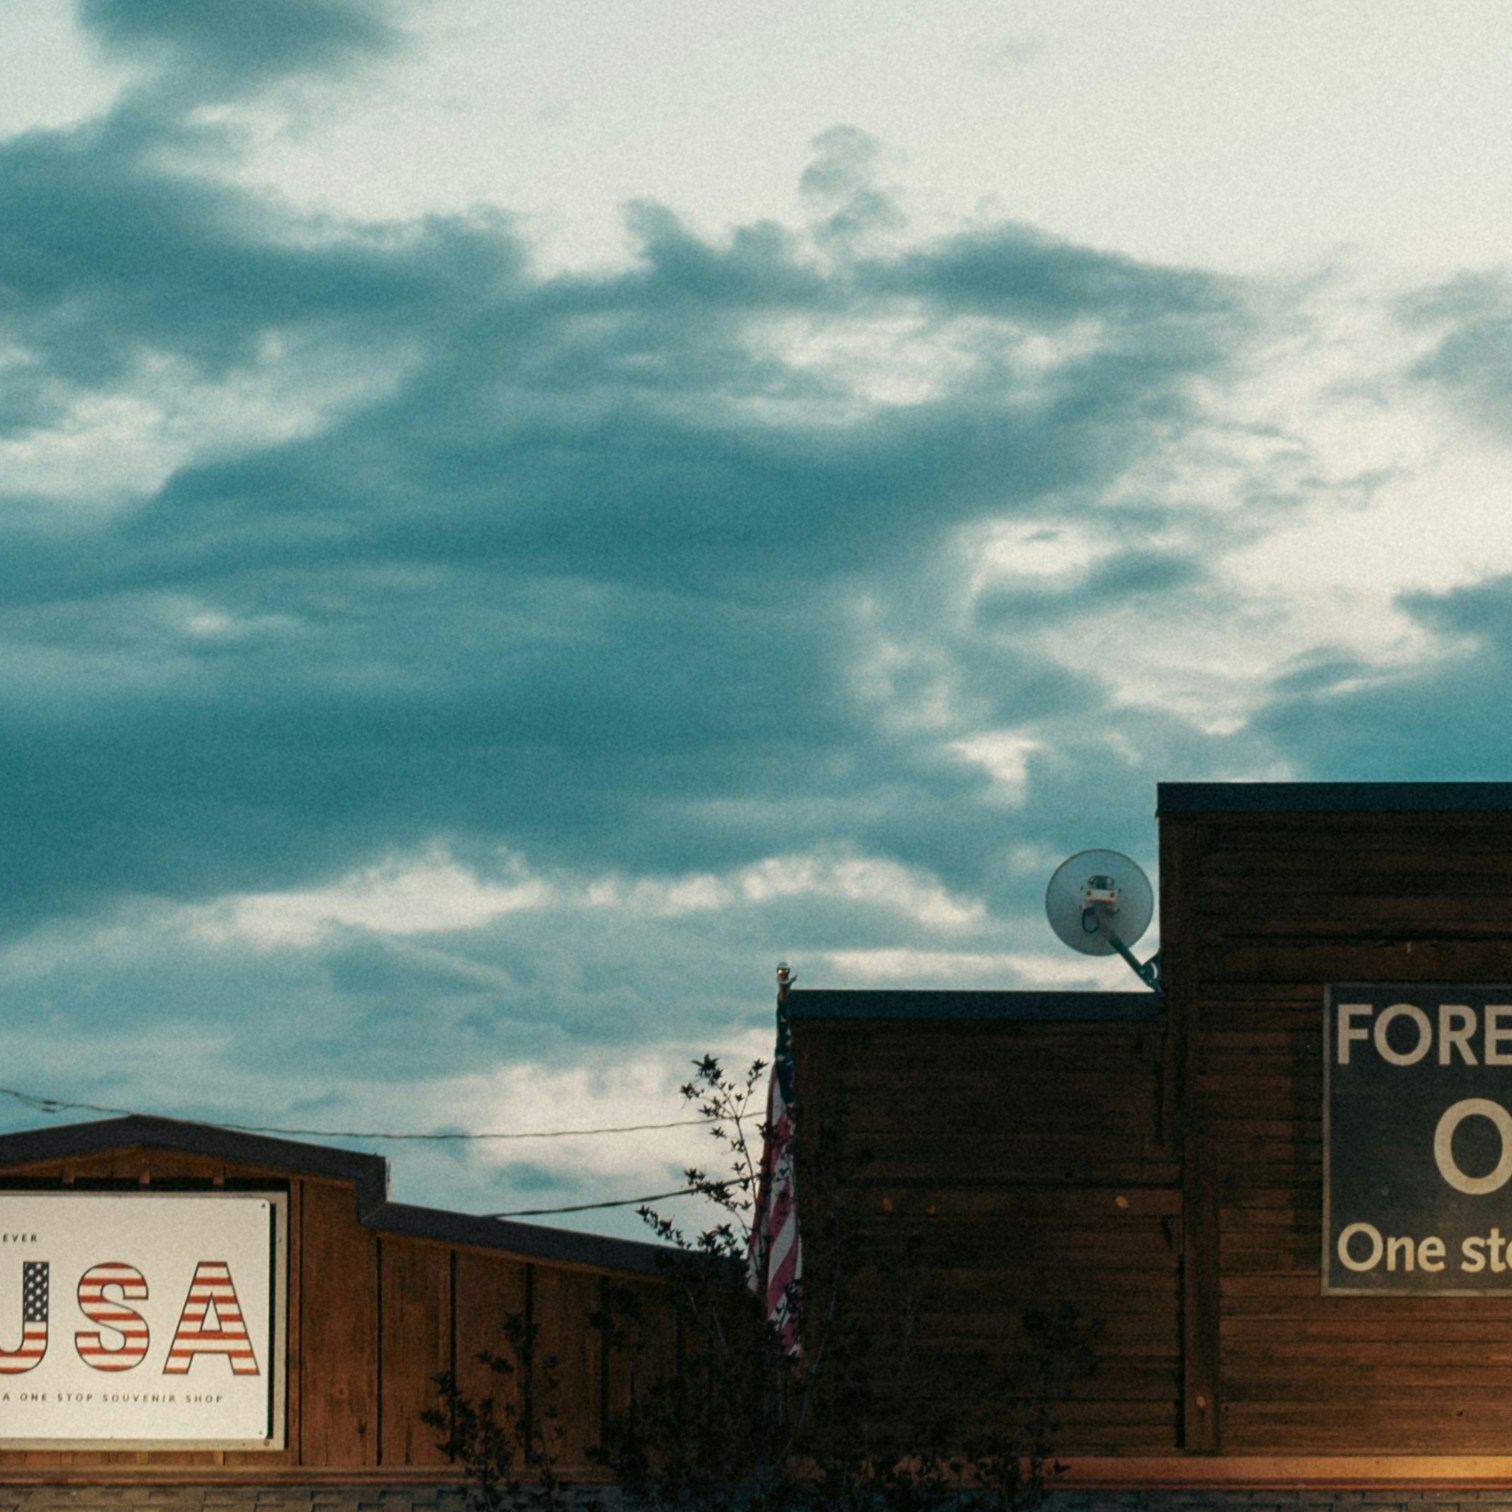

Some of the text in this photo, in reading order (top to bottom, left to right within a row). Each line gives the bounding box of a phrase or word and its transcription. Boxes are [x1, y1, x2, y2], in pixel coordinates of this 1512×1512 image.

[1337, 1222, 1446, 1273] One
[2, 1393, 224, 1405] A ONE STOP SOUVENIR SHOP
